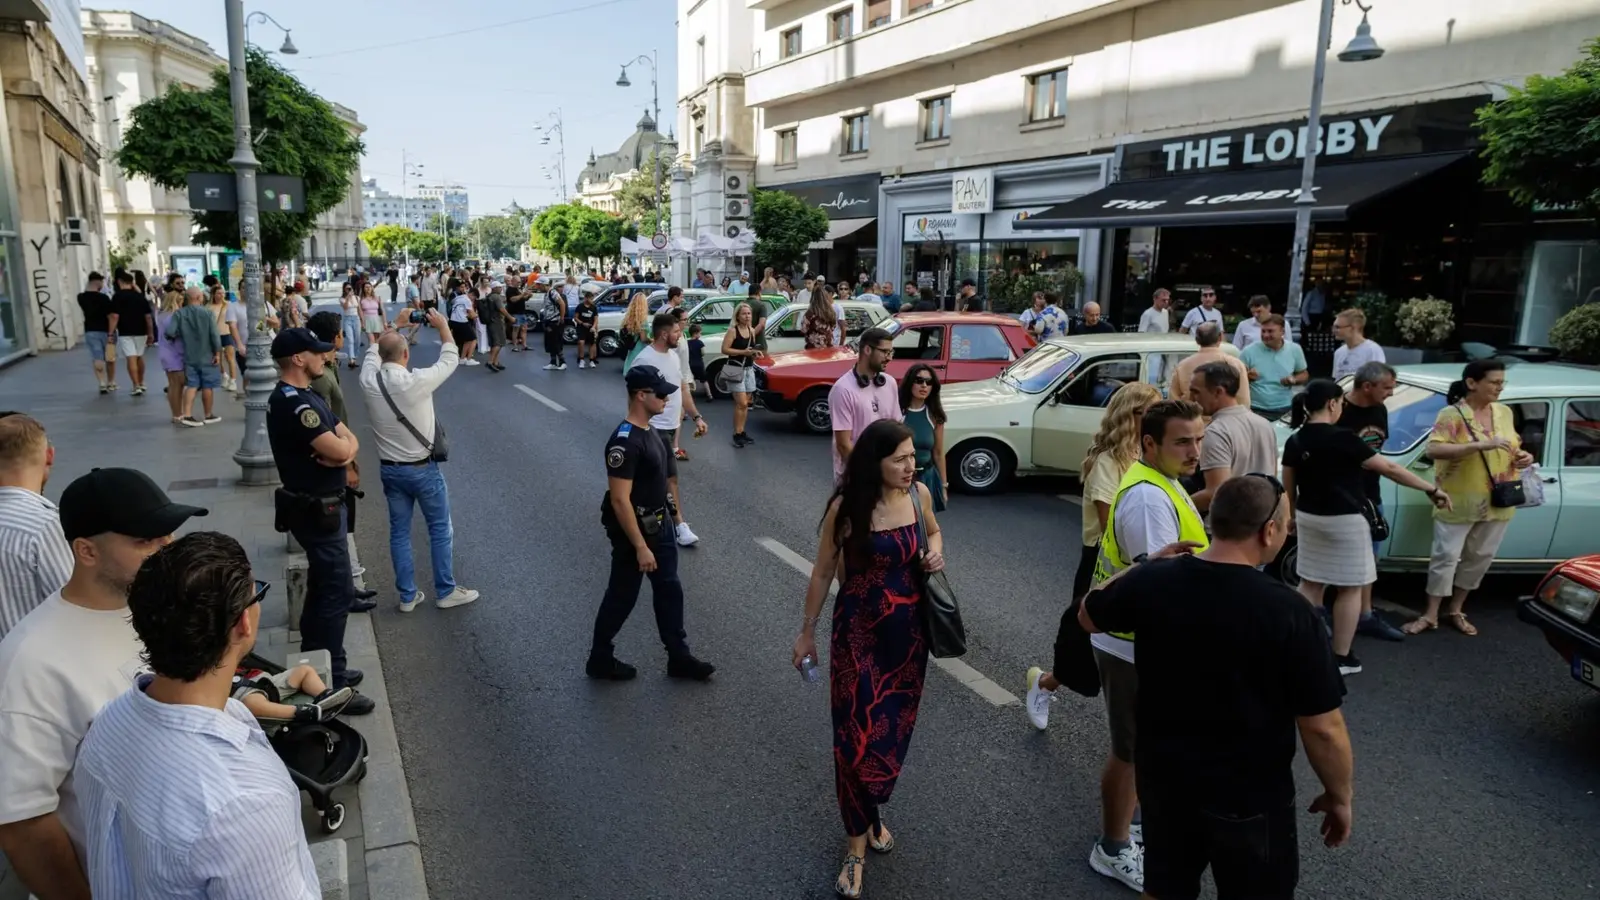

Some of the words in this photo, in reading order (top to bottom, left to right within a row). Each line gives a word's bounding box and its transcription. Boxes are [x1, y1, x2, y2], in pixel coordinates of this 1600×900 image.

[1163, 136, 1231, 171] THE
[1242, 115, 1393, 164] LOBBY
[955, 177, 987, 200] PAM
[1102, 199, 1167, 209] THE
[927, 217, 957, 229] ROMANIA
[31, 236, 58, 338] YERK
